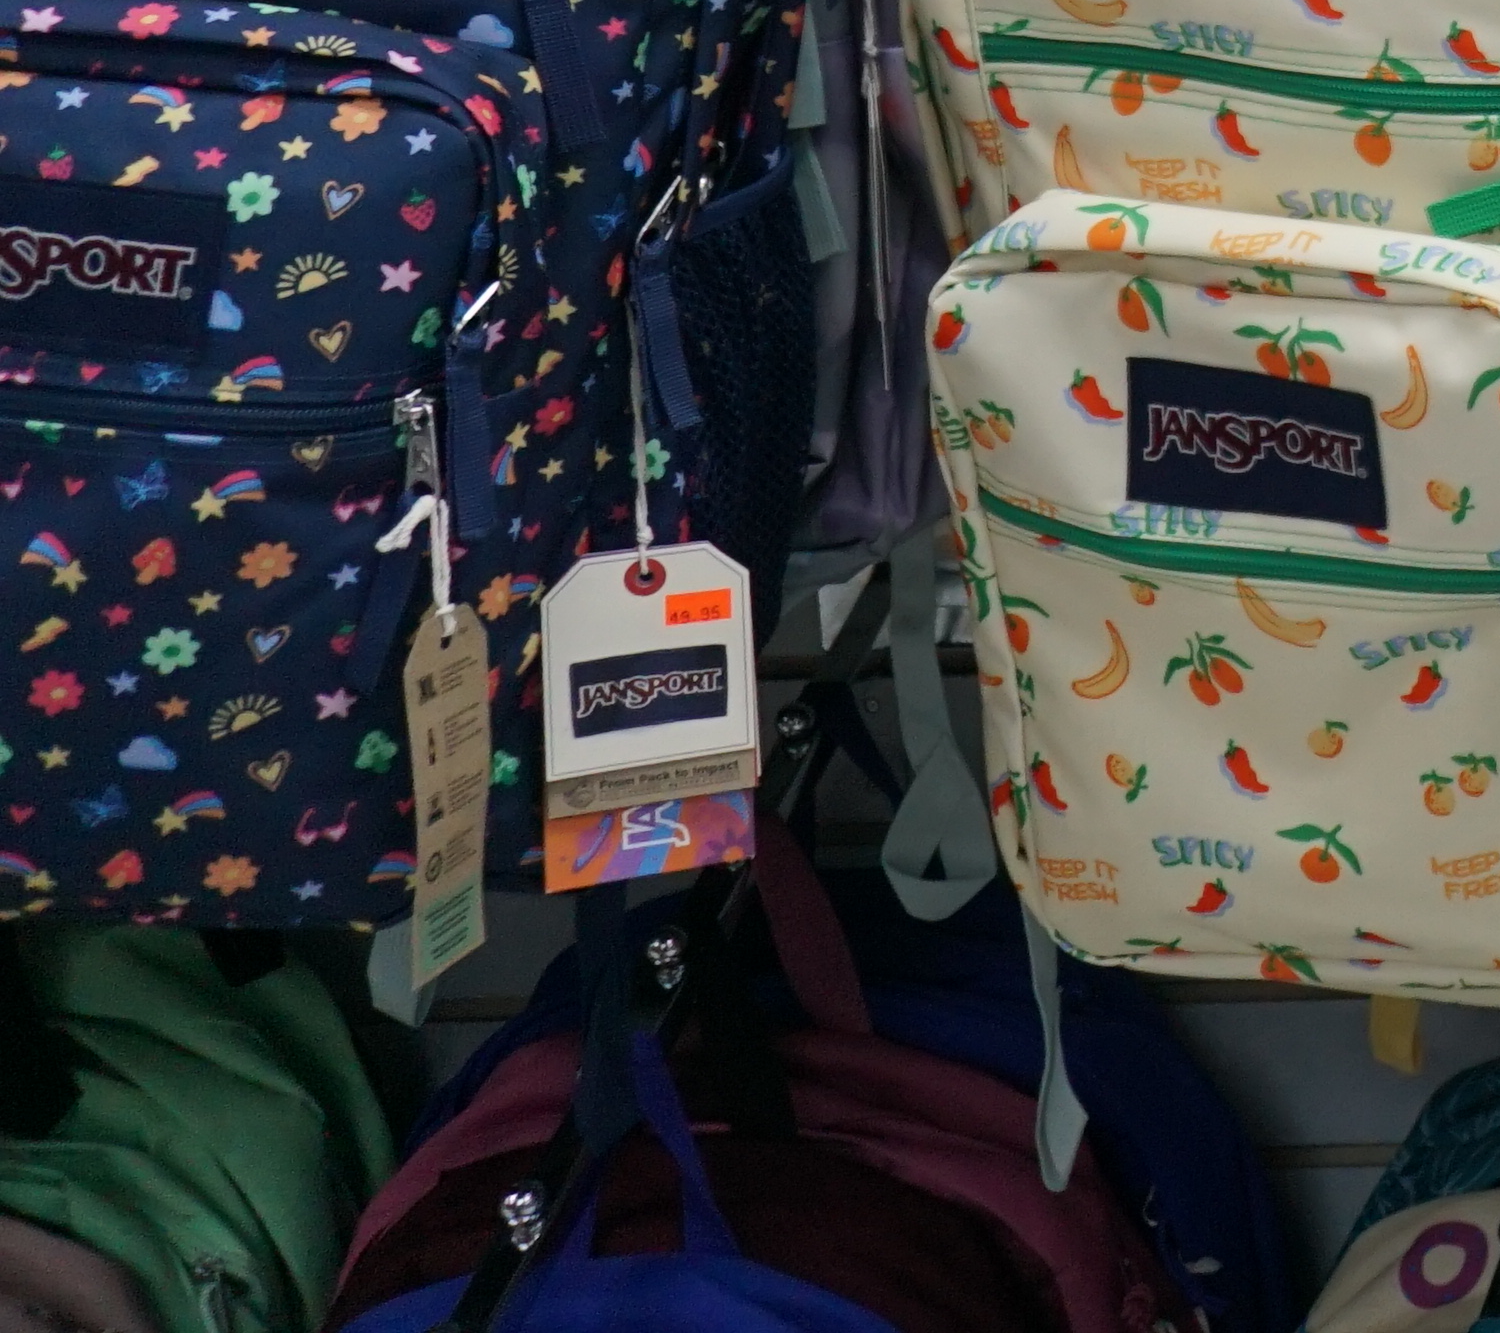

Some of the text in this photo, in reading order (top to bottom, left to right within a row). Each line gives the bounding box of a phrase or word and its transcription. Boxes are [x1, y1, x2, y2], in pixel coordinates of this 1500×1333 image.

[1151, 20, 1254, 57] SPICY
[1125, 152, 1222, 178] KEEP IT
[1138, 178, 1222, 204] FRESH
[1277, 188, 1394, 227] SPICY
[1210, 230, 1322, 257] KEEP IT
[0, 226, 196, 300] SPORT
[1143, 404, 1366, 477] JANSPORT
[1348, 625, 1473, 671] SPICY
[577, 668, 722, 718] JANSPORT
[600, 760, 739, 790] From Pack to Impact
[1151, 835, 1254, 873] SPICY
[1431, 849, 1500, 878] KEEP
[1094, 860, 1120, 882] IT
[1042, 881, 1120, 905] FRESH
